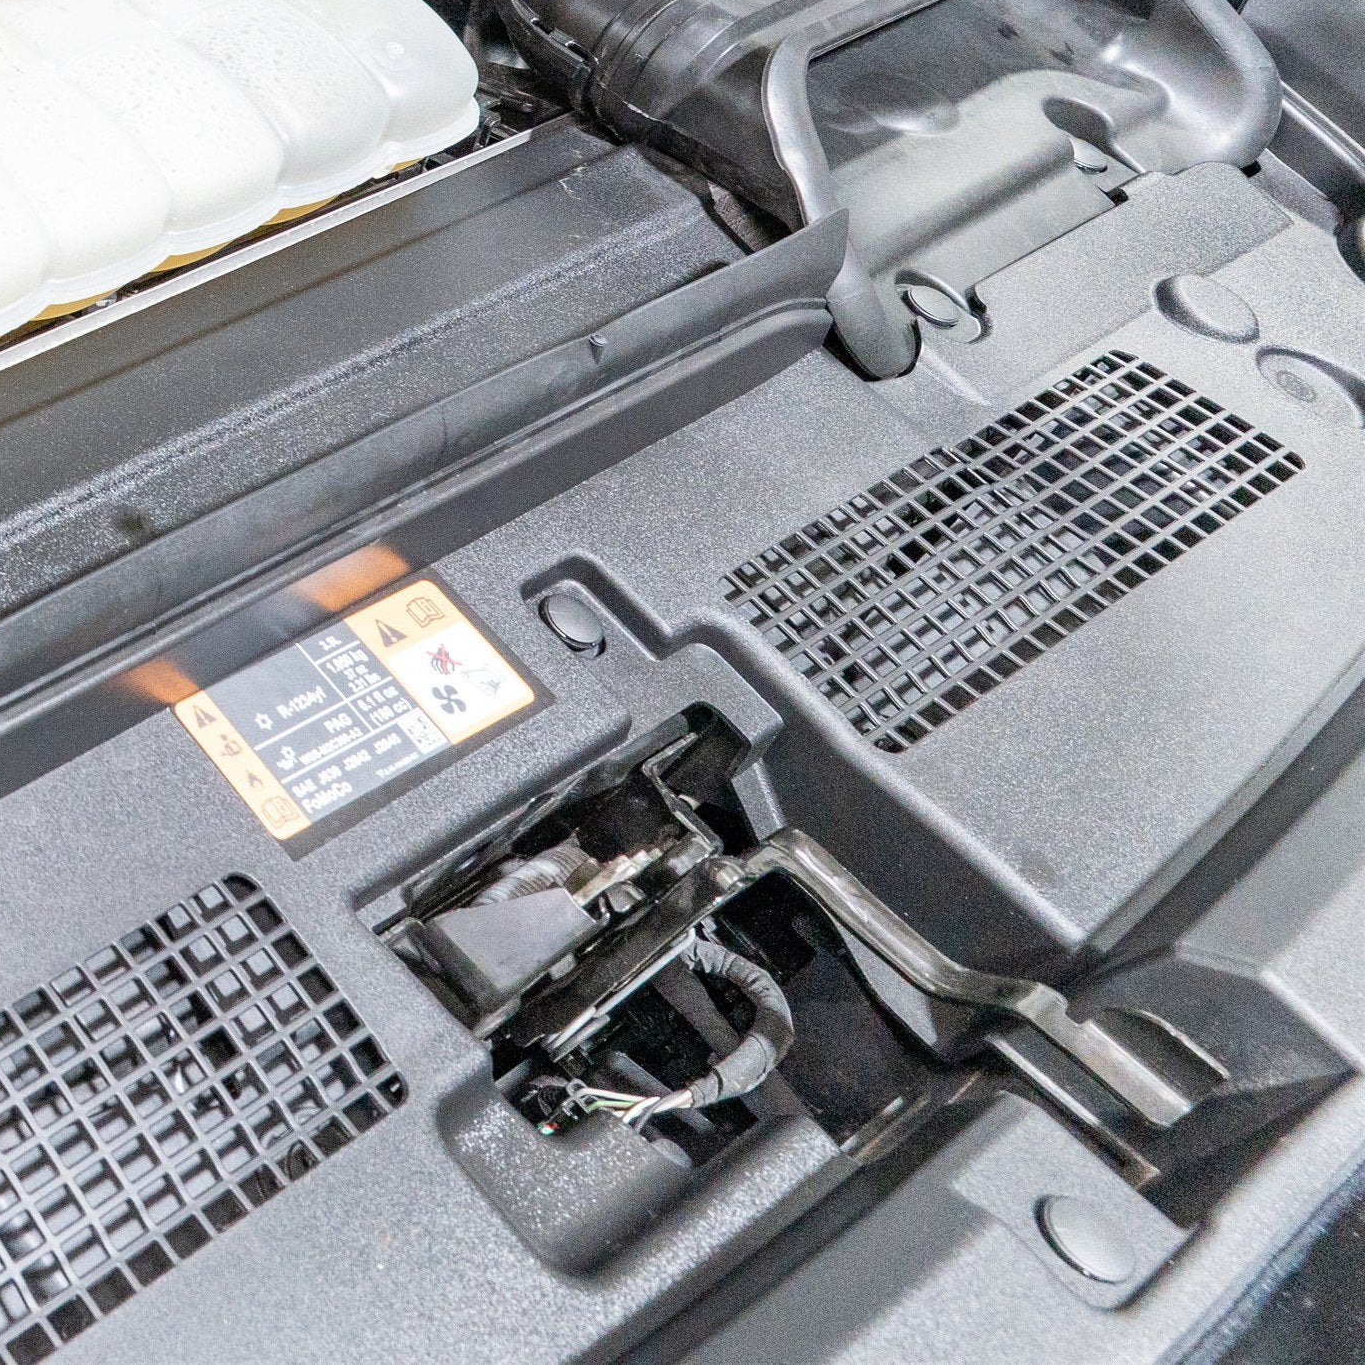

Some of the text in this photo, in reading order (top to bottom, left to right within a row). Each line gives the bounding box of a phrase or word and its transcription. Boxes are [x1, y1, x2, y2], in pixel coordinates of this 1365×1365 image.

[275, 684, 330, 720] R-1234yf
[322, 711, 354, 734] PAG
[290, 777, 318, 799] SAE
[299, 776, 355, 815] FoMoCo
